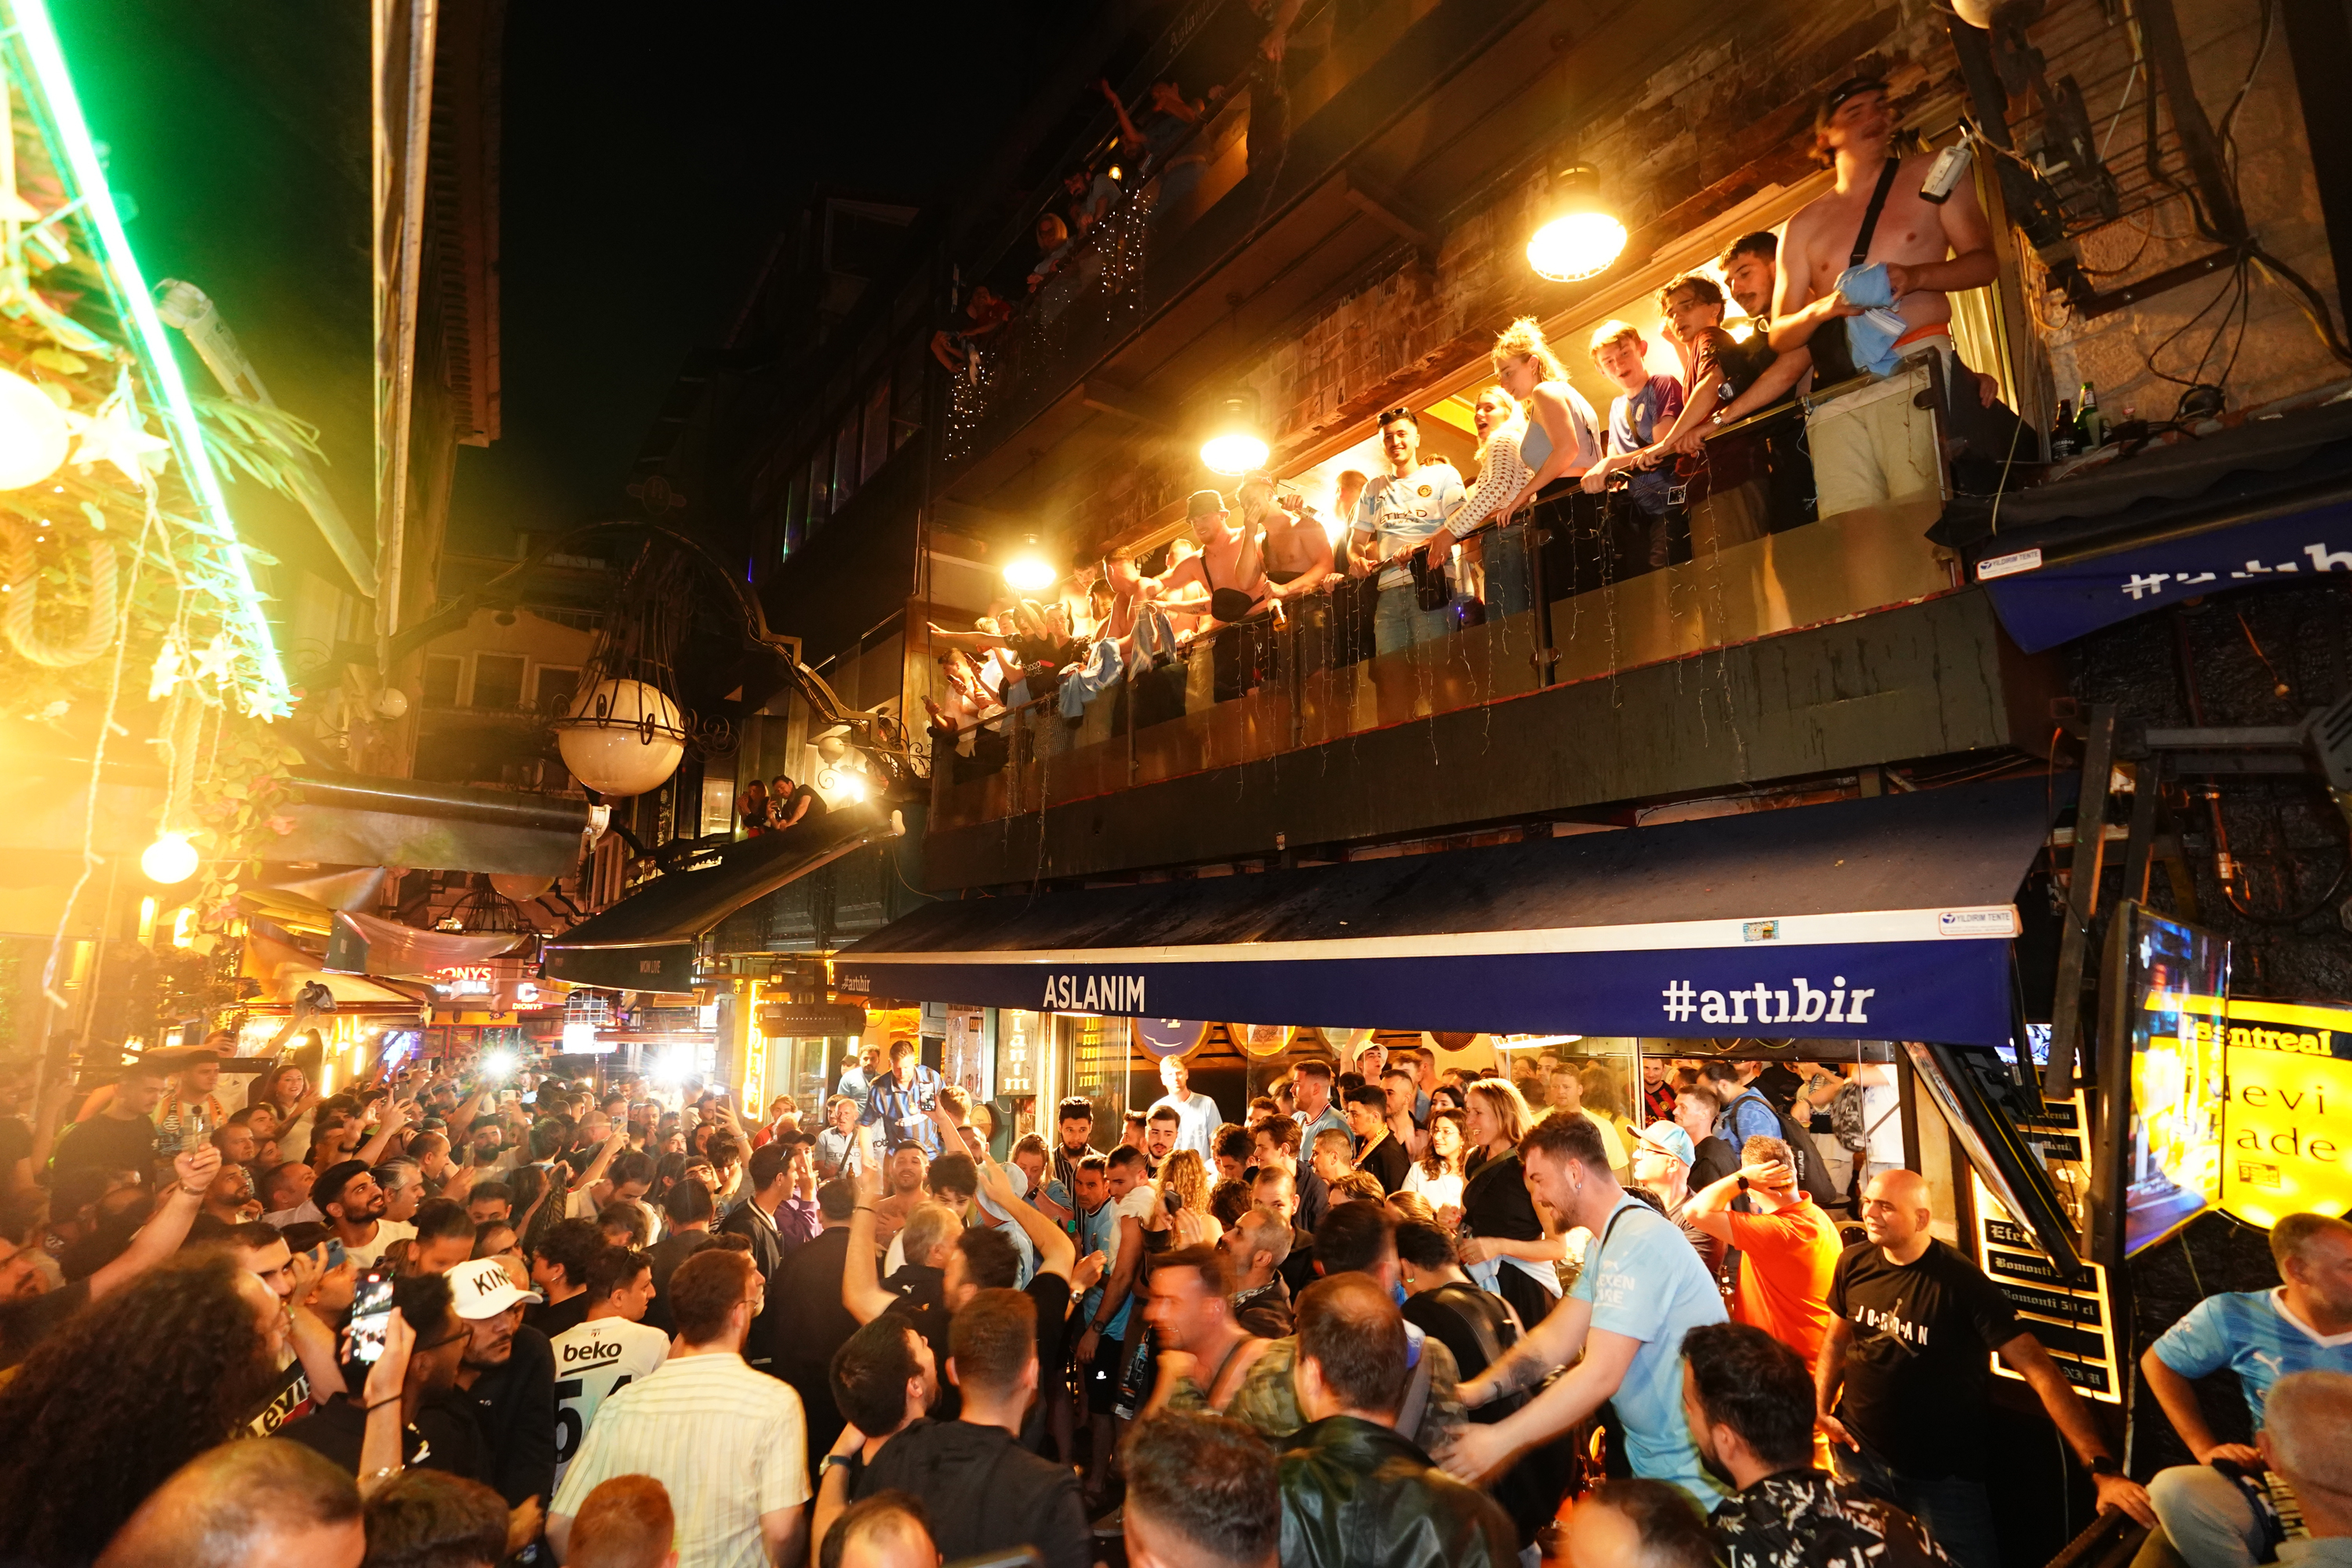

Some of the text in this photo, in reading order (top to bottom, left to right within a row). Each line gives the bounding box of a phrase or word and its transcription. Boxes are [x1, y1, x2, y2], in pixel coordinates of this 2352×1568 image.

[1043, 975, 1145, 1013] ASLANIM
[1995, 1257, 2051, 1276] Bomonti
[473, 1268, 510, 1296] KIN
[563, 1341, 622, 1363] beko
[554, 1374, 632, 1464] 5
